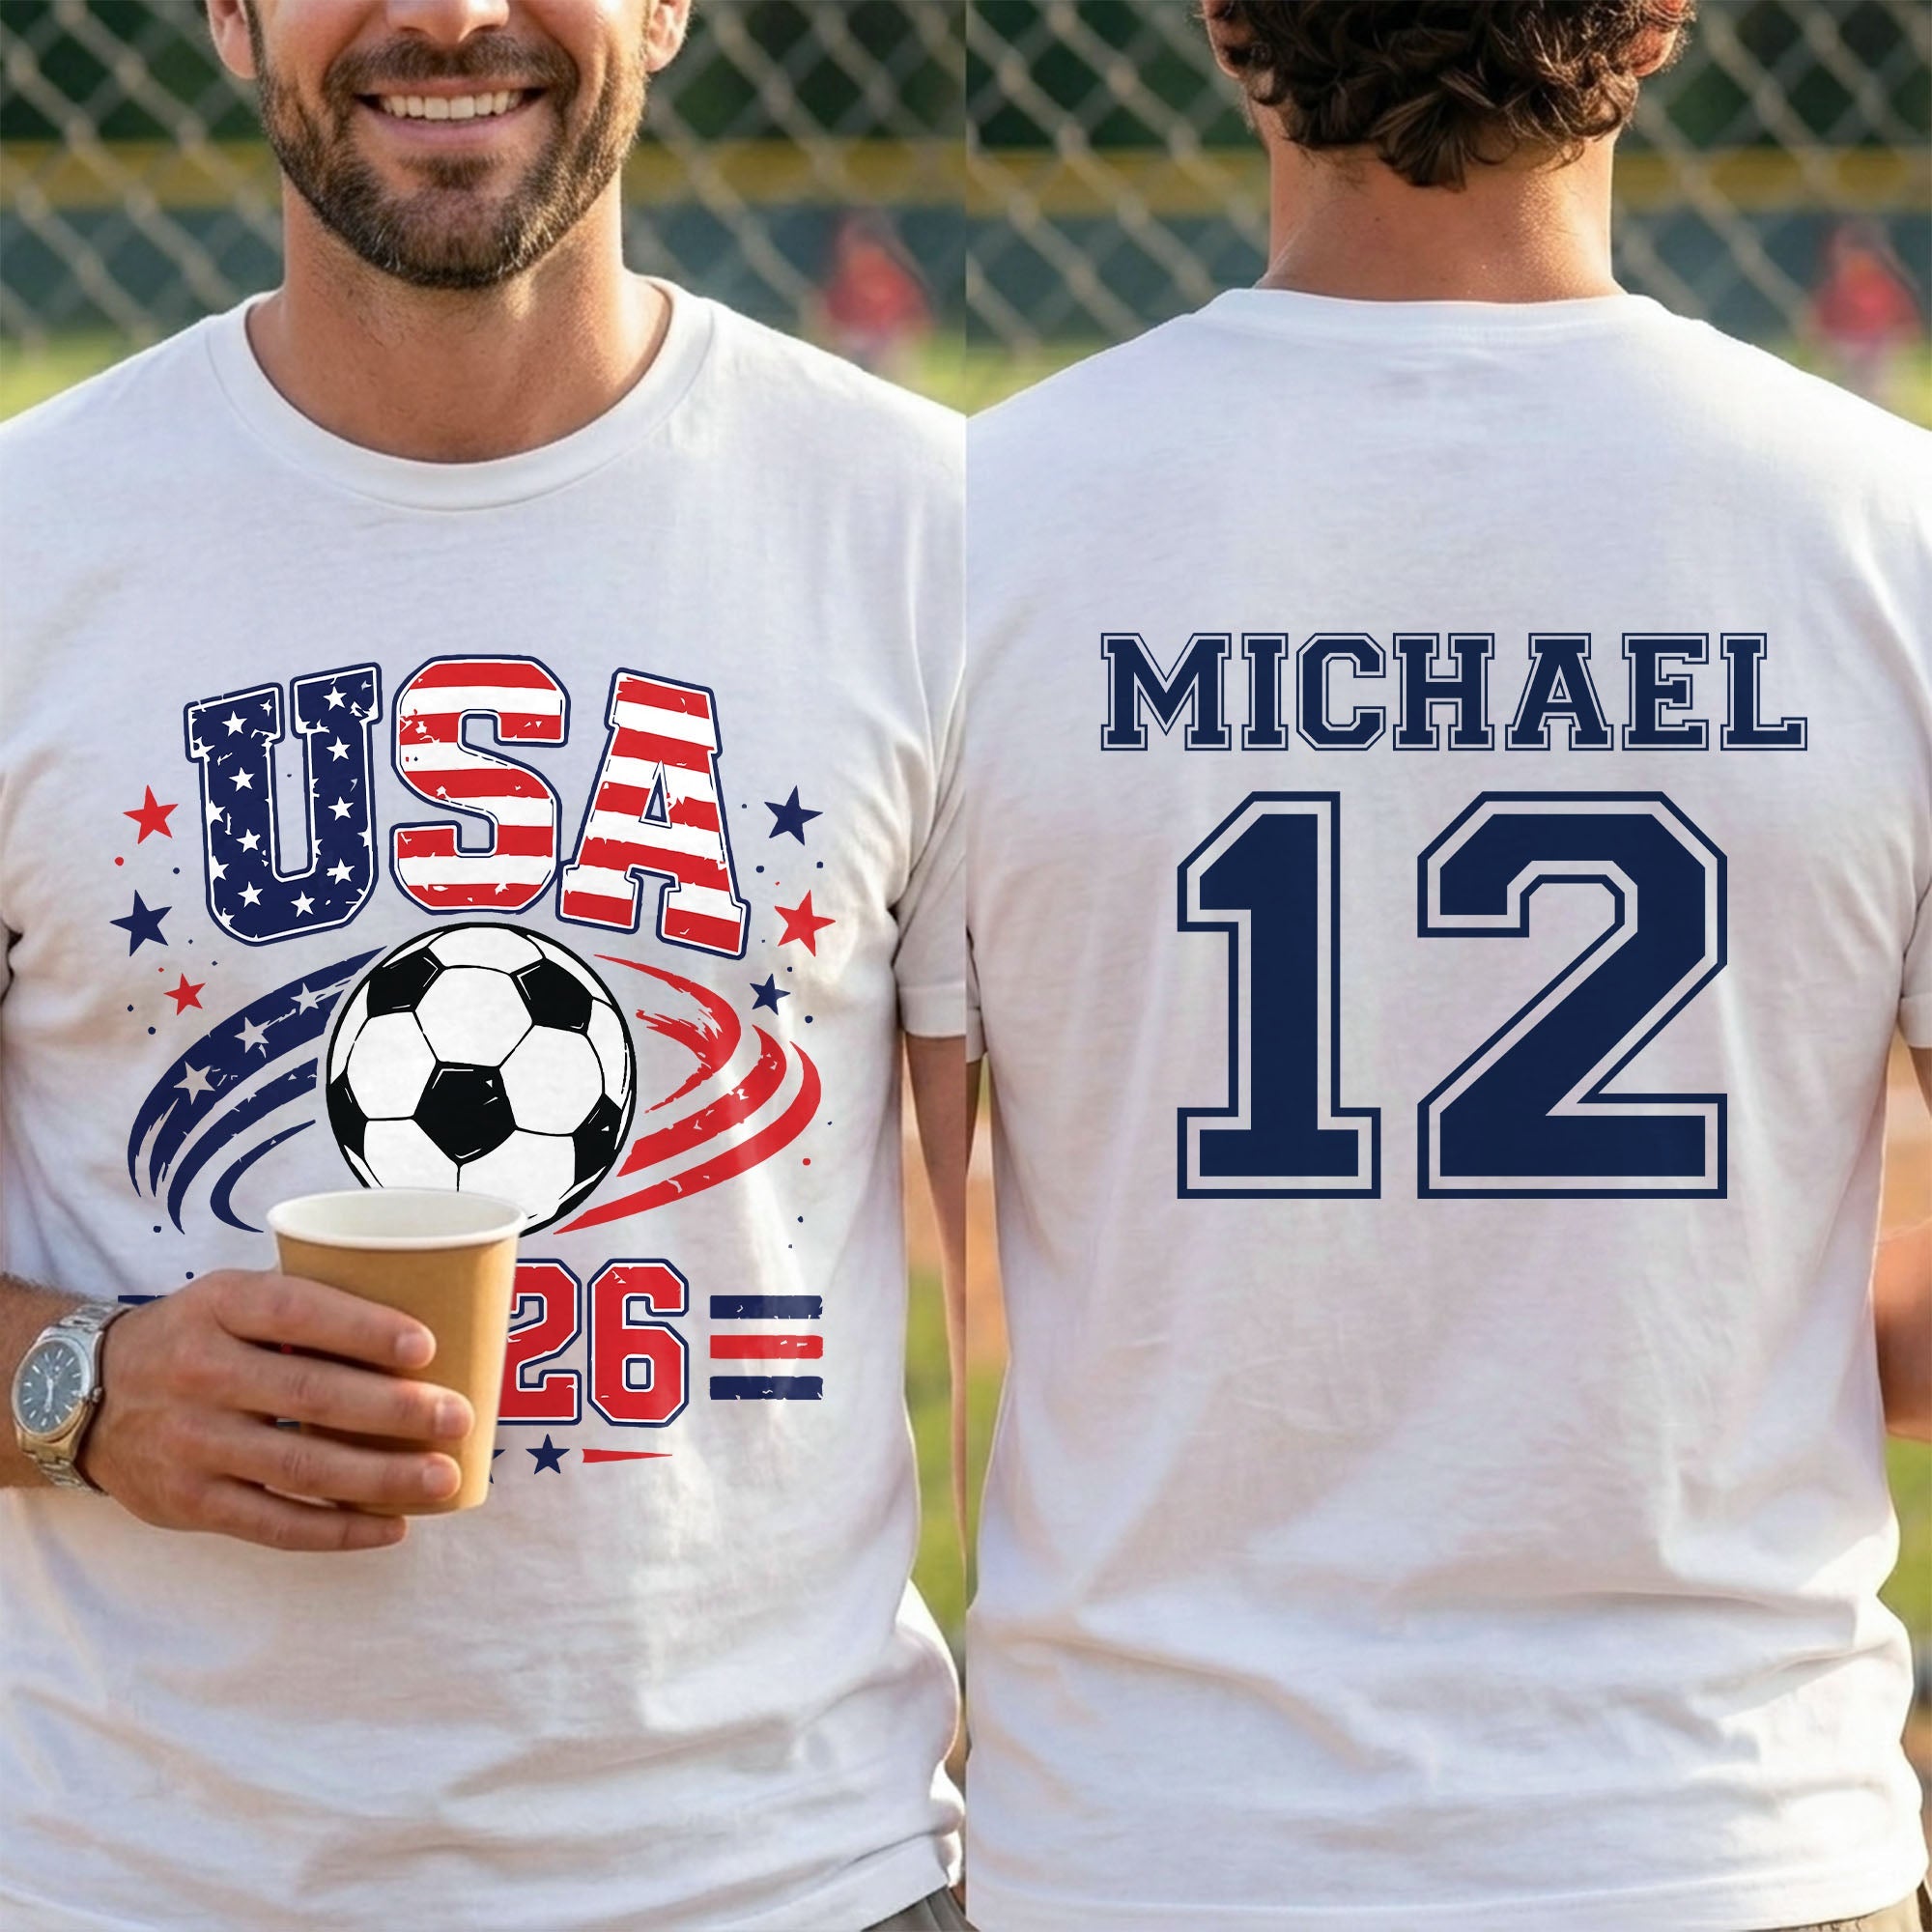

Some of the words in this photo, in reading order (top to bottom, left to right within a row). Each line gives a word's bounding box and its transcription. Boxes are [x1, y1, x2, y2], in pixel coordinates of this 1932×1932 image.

[184, 654, 751, 960] USA
[1101, 633, 1808, 752] MICHAEL
[1178, 791, 1728, 1200] 12
[497, 1259, 690, 1429] 26
